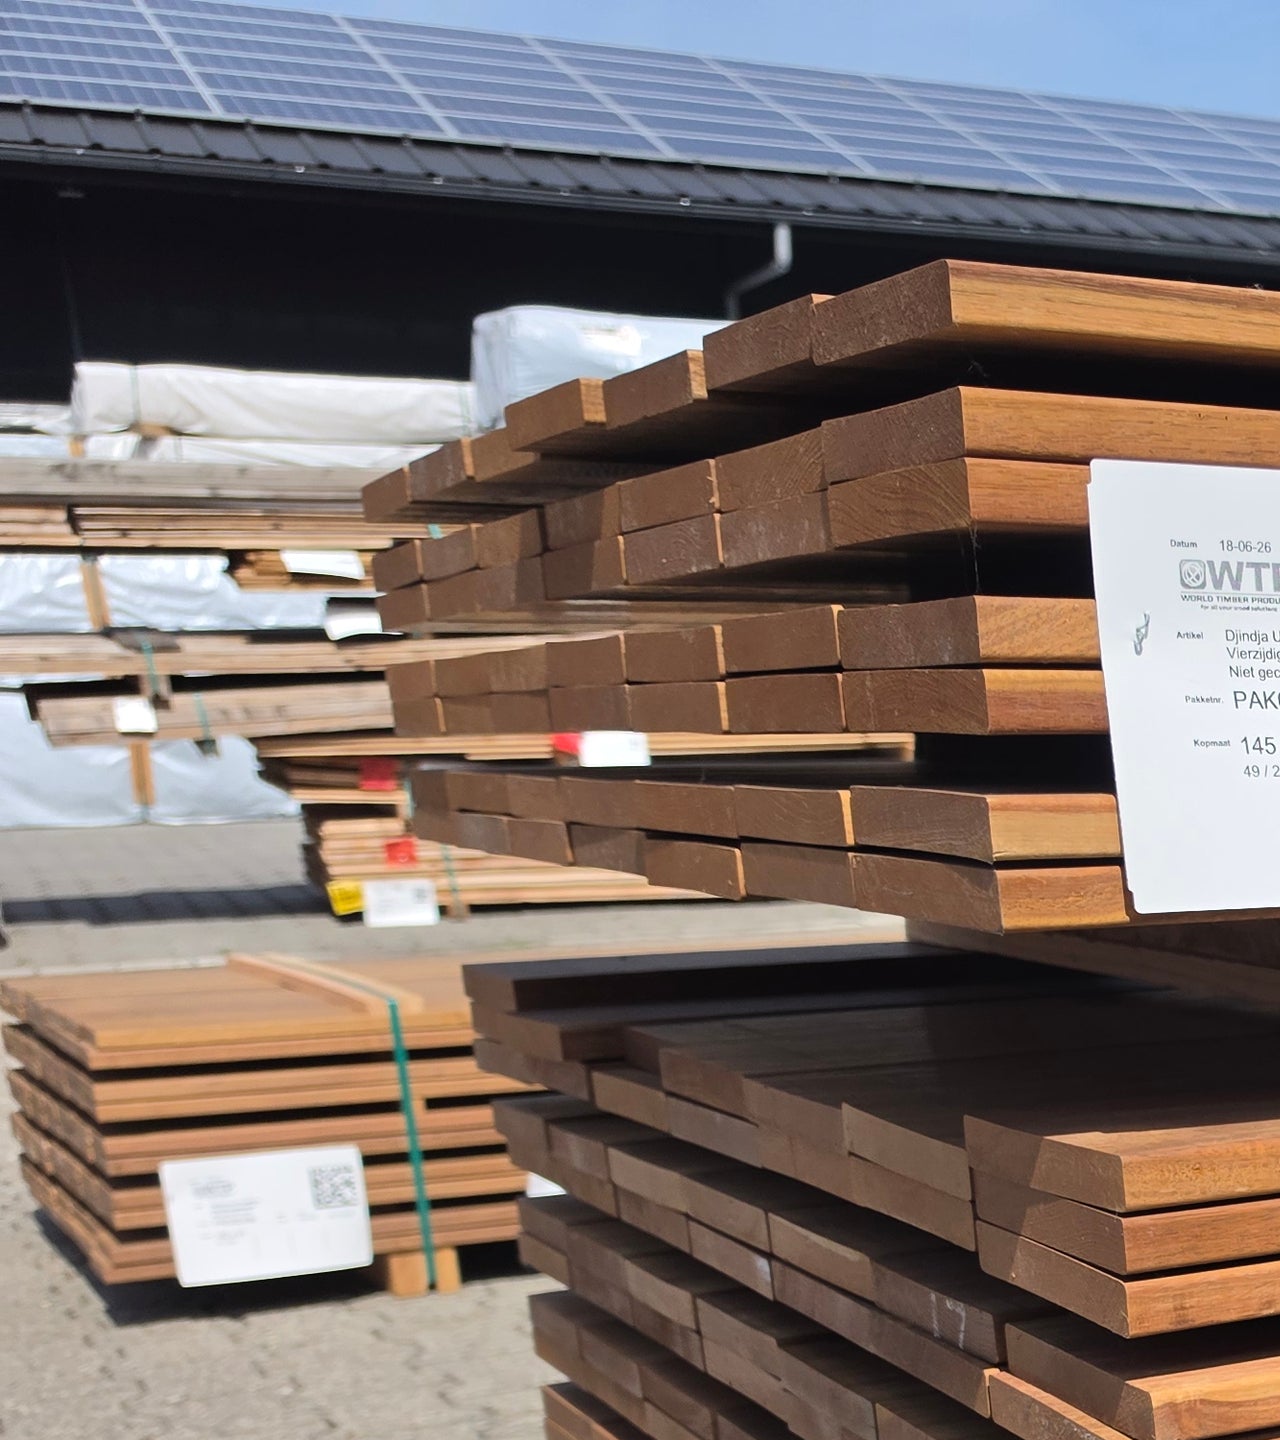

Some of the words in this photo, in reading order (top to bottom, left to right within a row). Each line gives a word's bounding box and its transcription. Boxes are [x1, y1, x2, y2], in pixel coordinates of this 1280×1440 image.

[1170, 539, 1198, 548] Datum
[1219, 540, 1272, 553] 18-06-26
[1180, 594, 1213, 602] WORLD
[1216, 595, 1248, 603] TIMBER
[1176, 631, 1204, 640] Artikel
[1225, 629, 1269, 645] Djindja
[1229, 665, 1255, 678] Niet
[1184, 695, 1225, 704] Pakketnr.
[1193, 738, 1231, 748] Kopmaat
[1241, 736, 1277, 755] 145
[1243, 764, 1260, 778] 49
